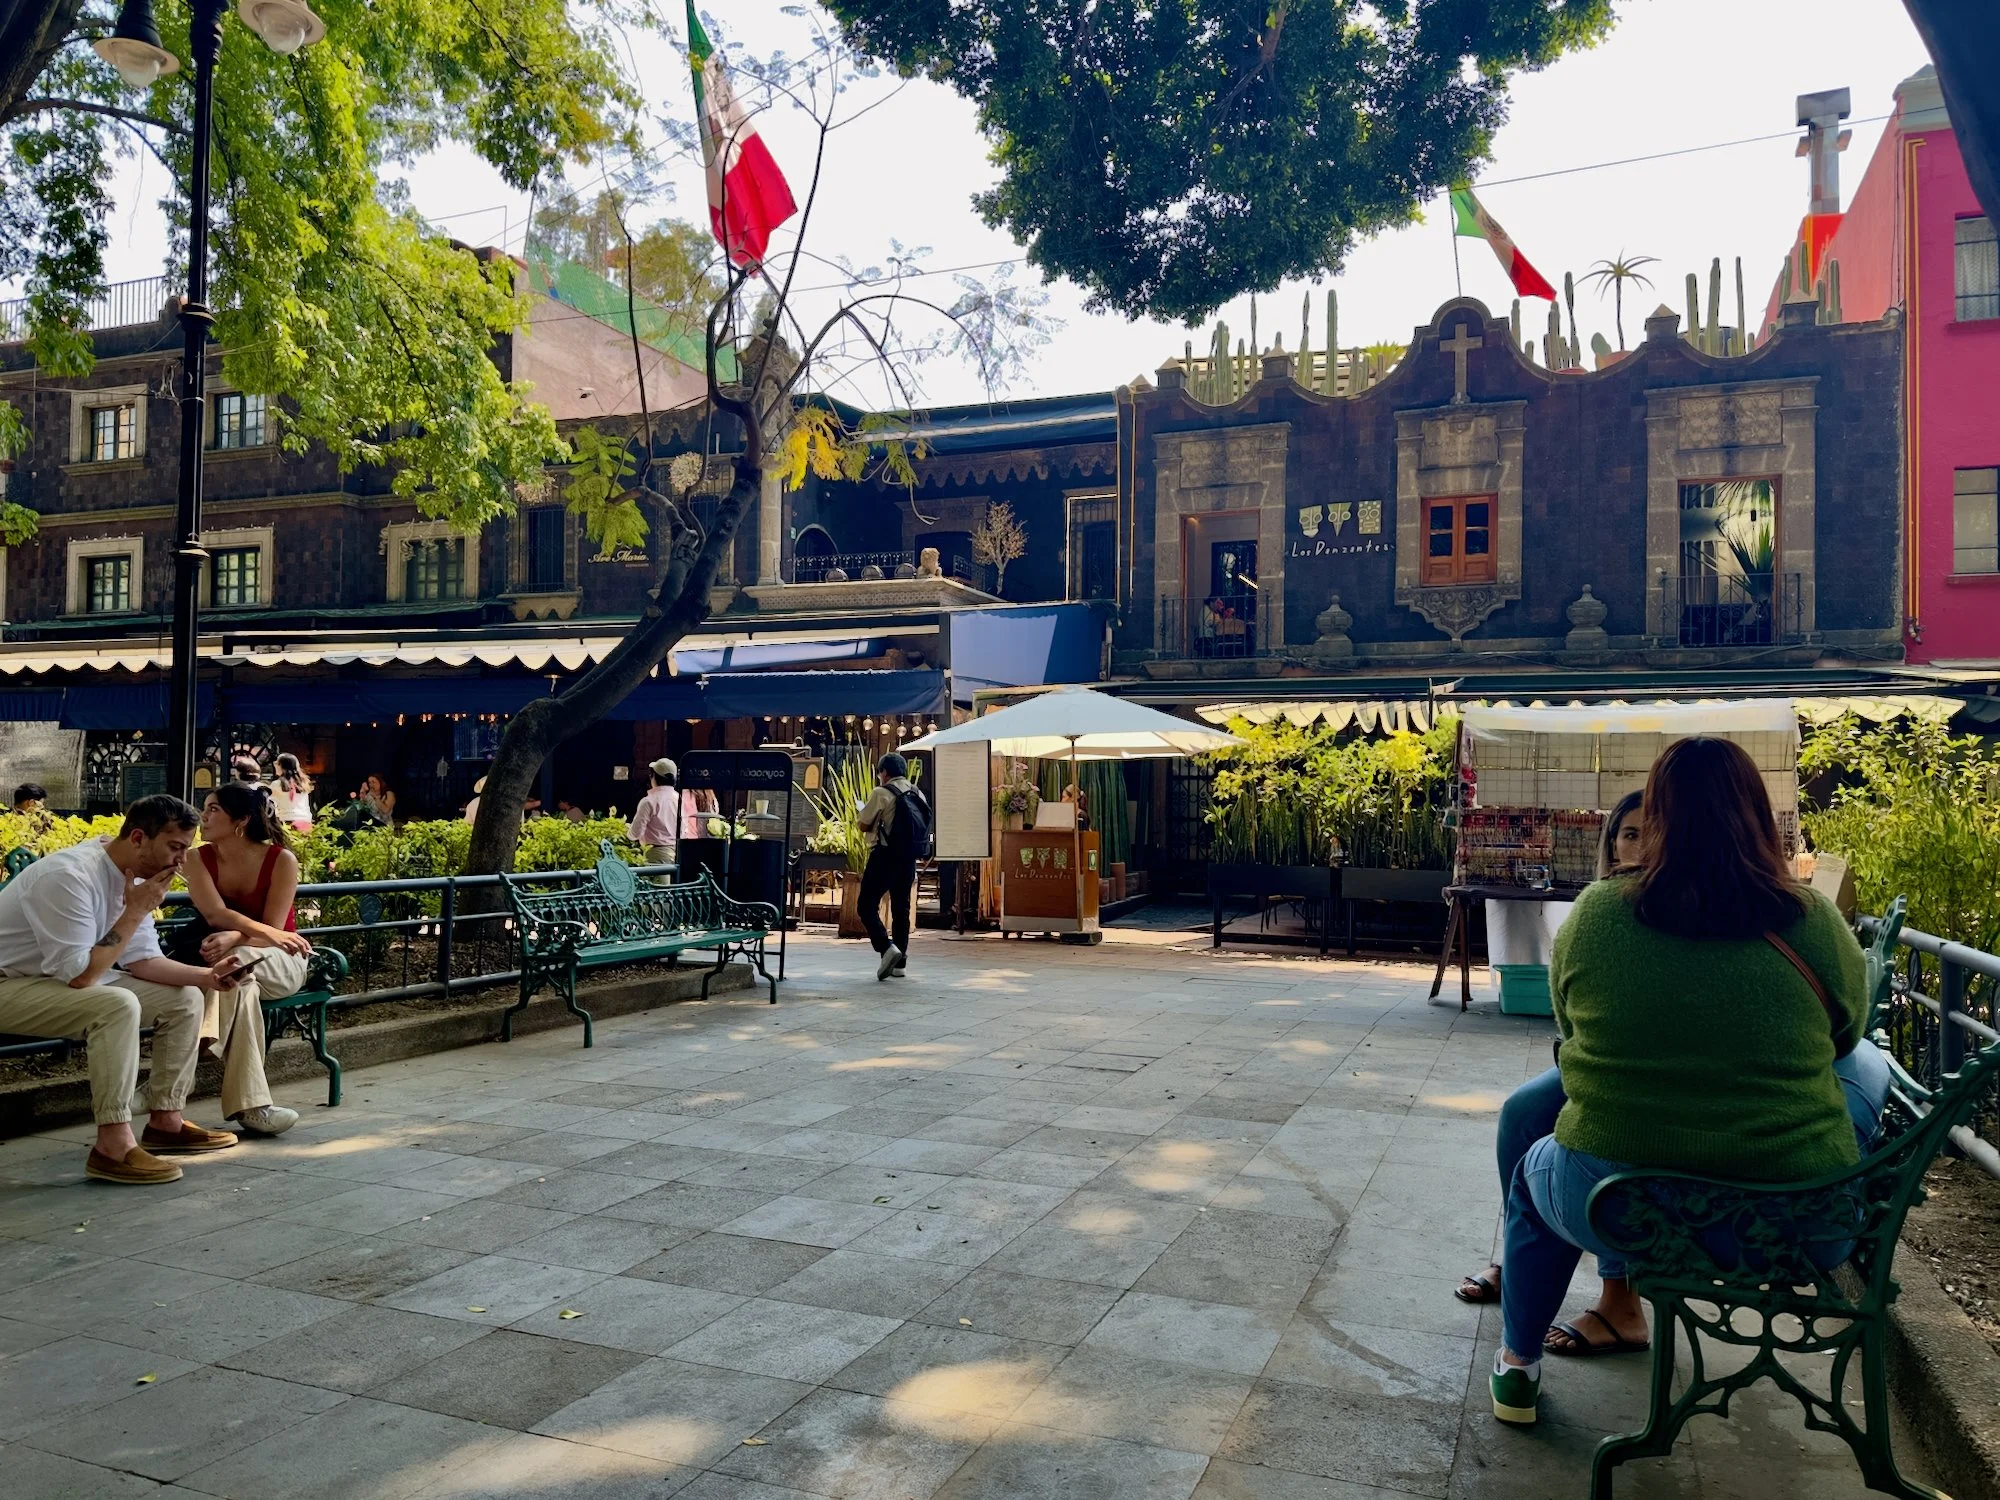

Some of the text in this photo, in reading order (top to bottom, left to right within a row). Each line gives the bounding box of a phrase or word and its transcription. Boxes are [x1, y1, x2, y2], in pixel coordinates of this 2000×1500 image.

[1292, 539, 1389, 557] Los Danzantes
[1015, 868, 1027, 879] Los
